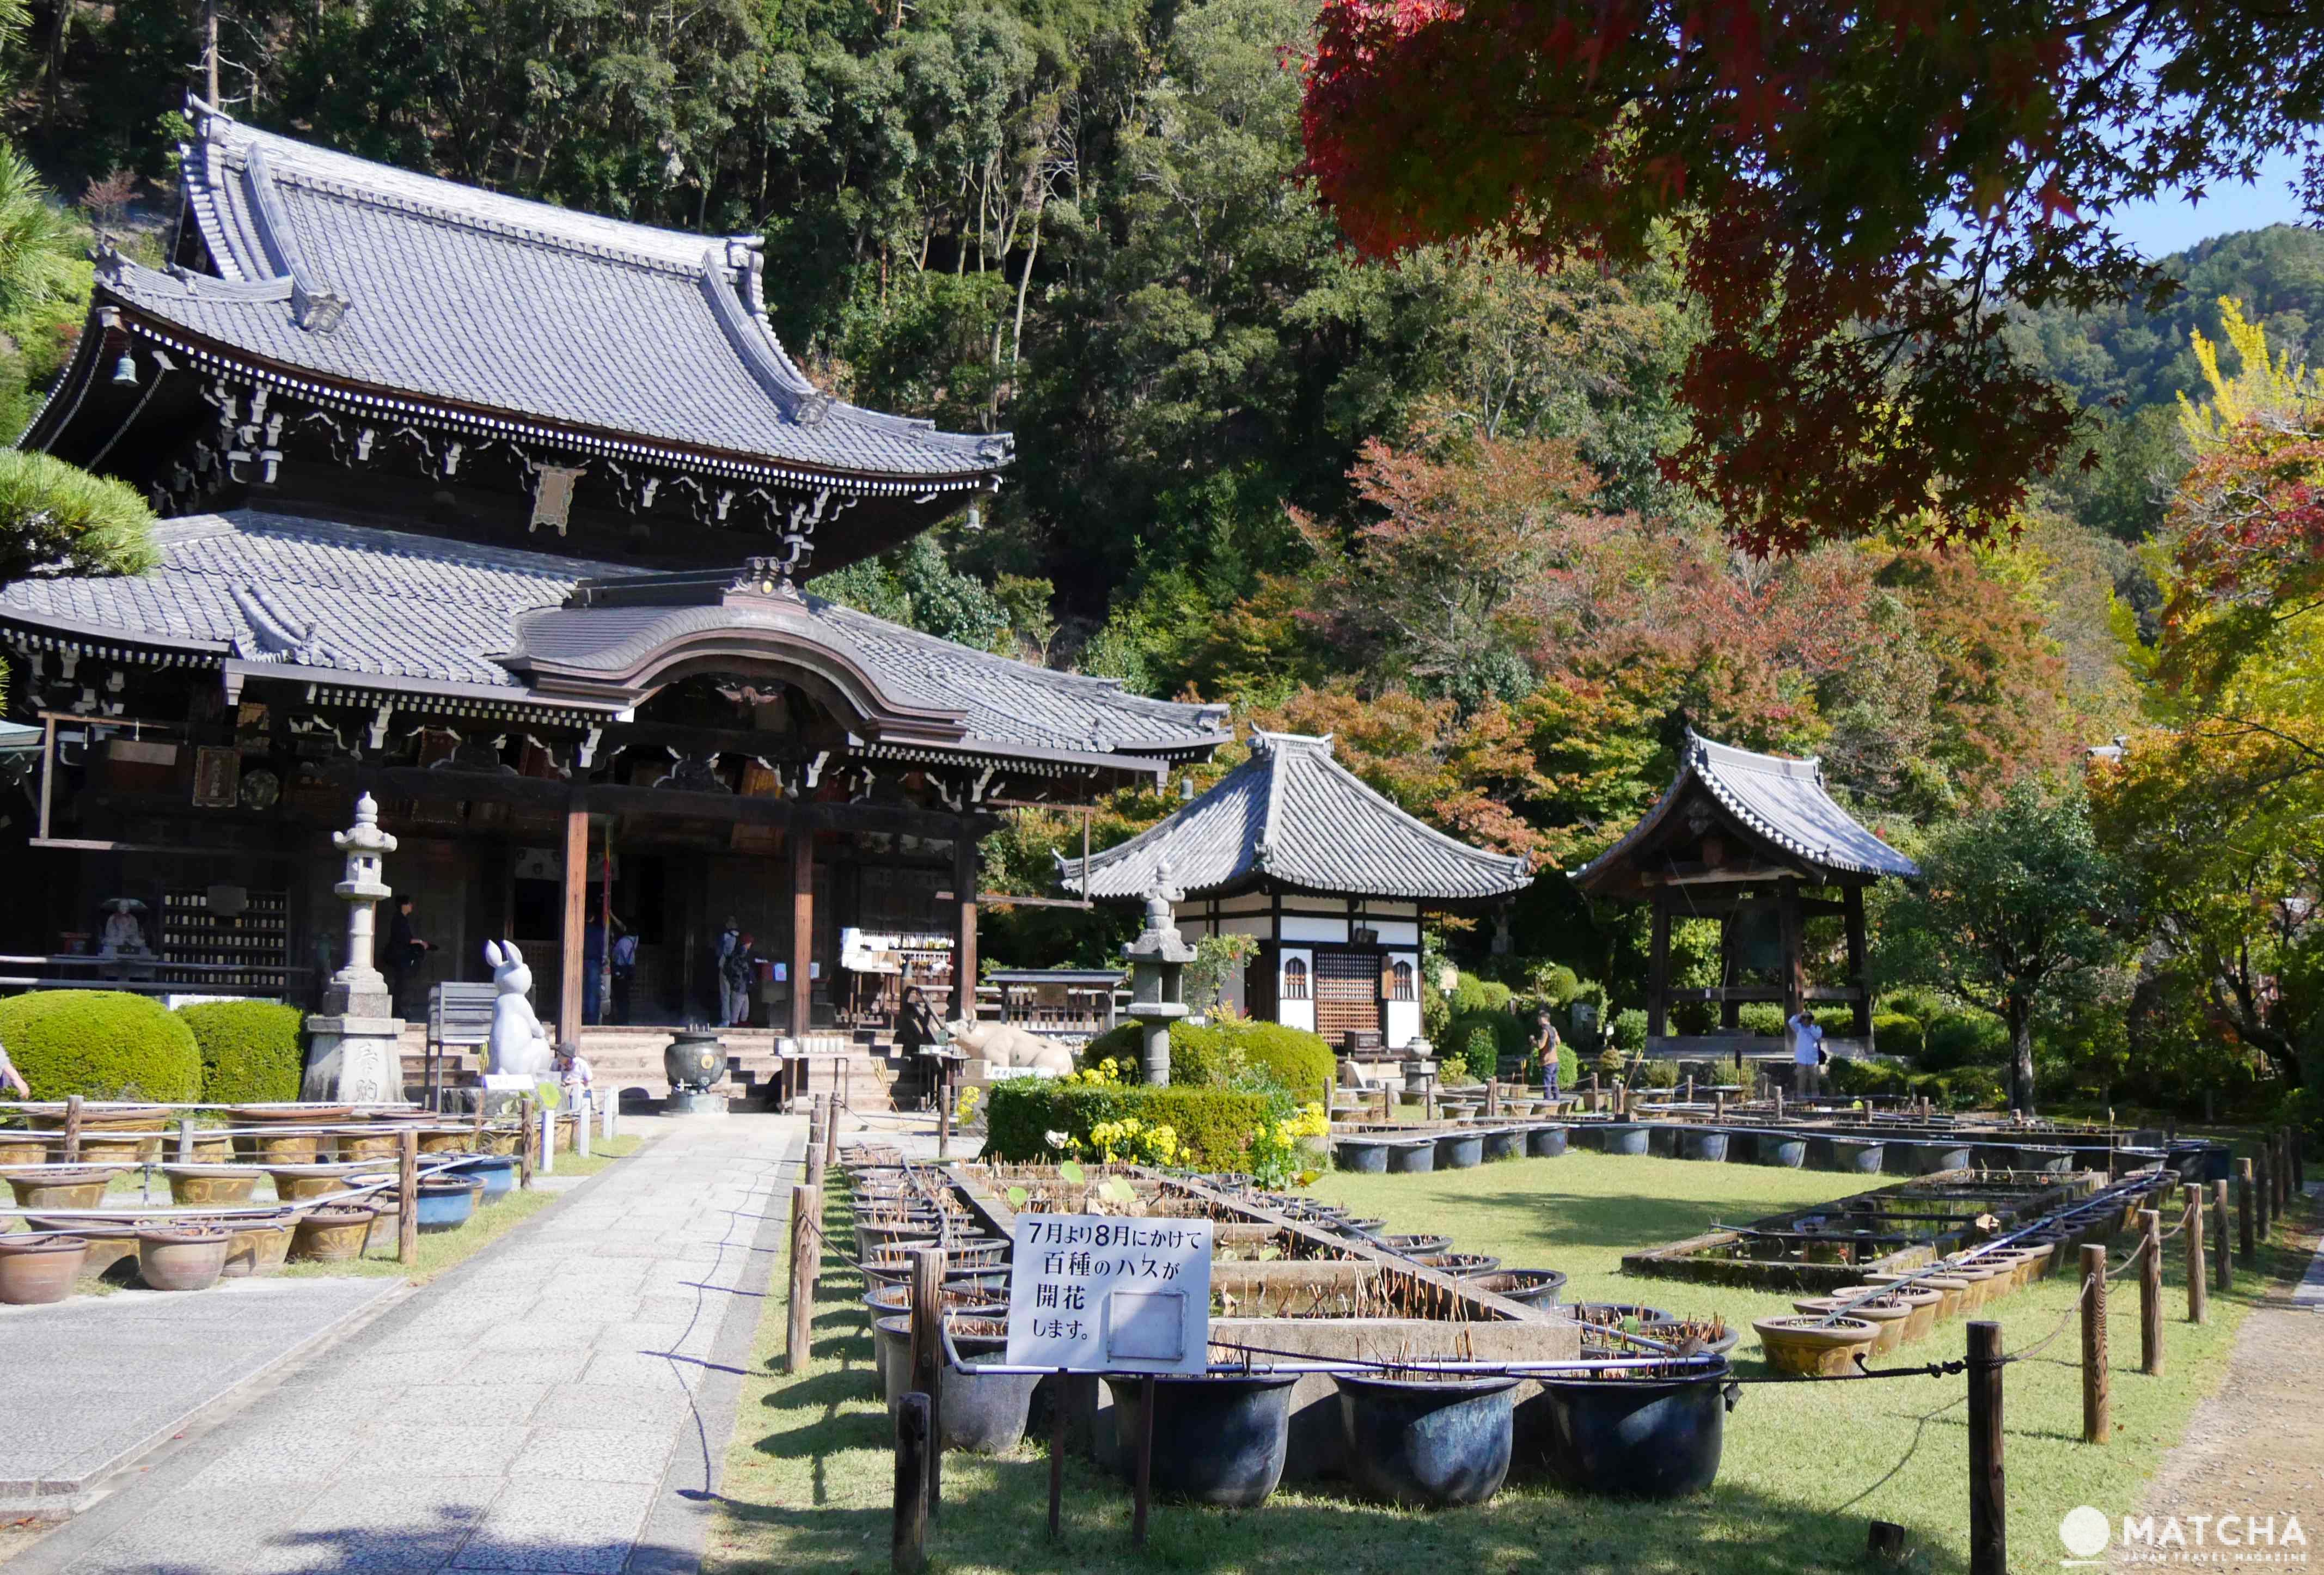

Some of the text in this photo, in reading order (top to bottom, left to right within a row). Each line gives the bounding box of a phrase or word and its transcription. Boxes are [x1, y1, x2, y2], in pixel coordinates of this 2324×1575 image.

[1028, 1222, 1202, 1249] 7月より8月にかけて
[1043, 1251, 1180, 1280] 百種のハスが
[1036, 1283, 1086, 1310] 開花
[1033, 1319, 1088, 1340] します。
